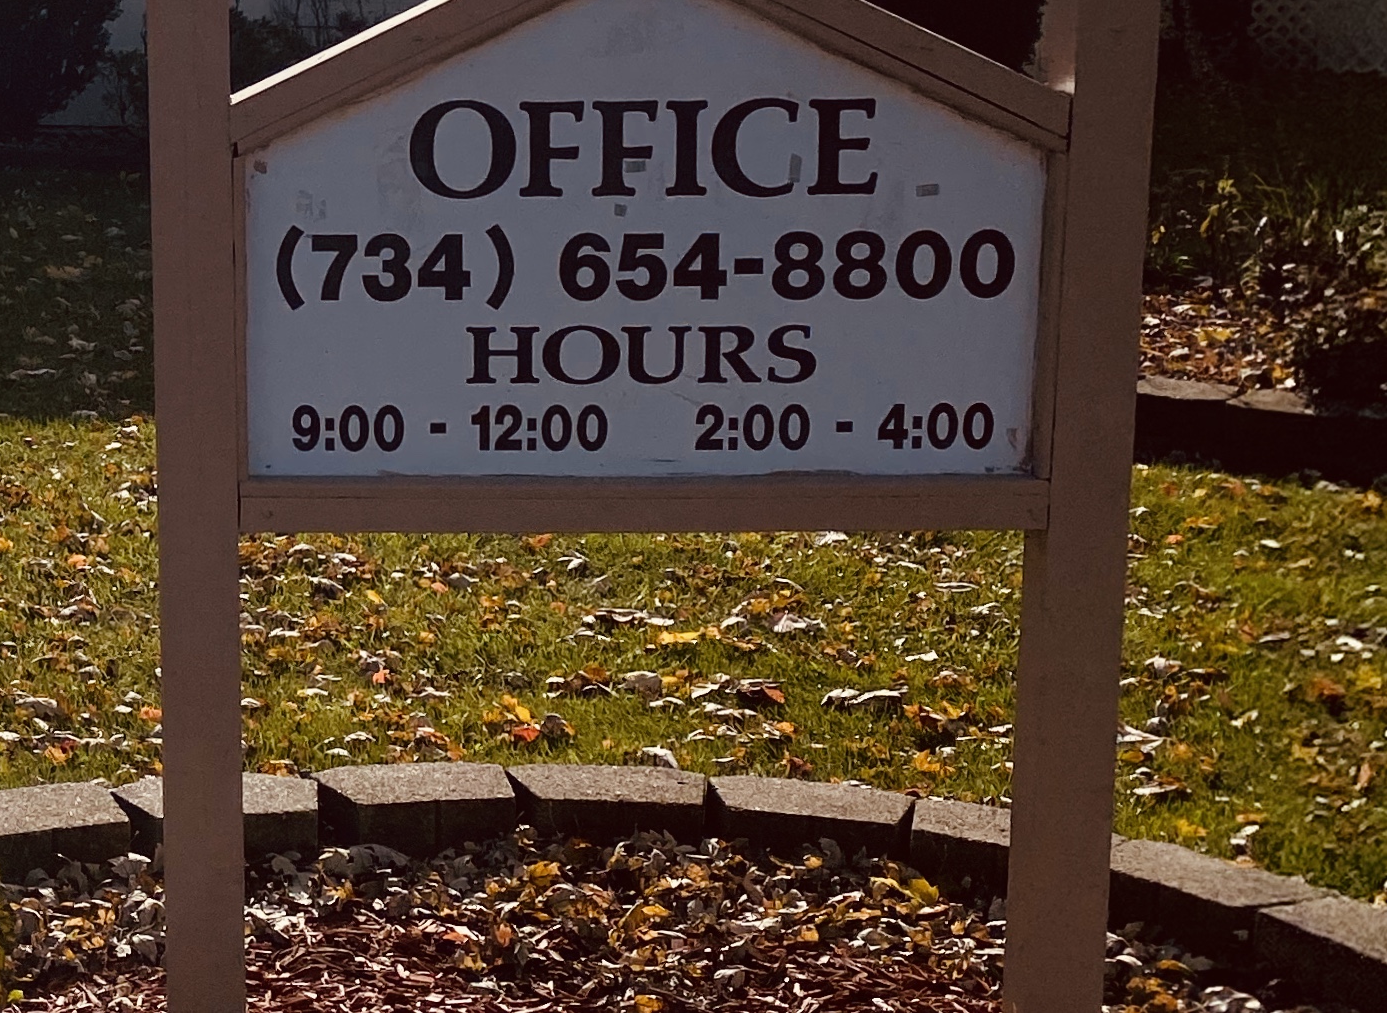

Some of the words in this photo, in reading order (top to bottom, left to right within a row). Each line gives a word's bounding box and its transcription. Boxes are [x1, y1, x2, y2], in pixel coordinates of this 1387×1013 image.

[409, 97, 879, 200] OFFICE
[276, 224, 515, 311] (734)
[559, 228, 1016, 302] 654-8800
[465, 324, 817, 385] HOURS
[292, 404, 405, 453] 9:00
[471, 404, 608, 452] 12:00
[694, 403, 811, 451] 2:00
[877, 402, 995, 450] 4:00
